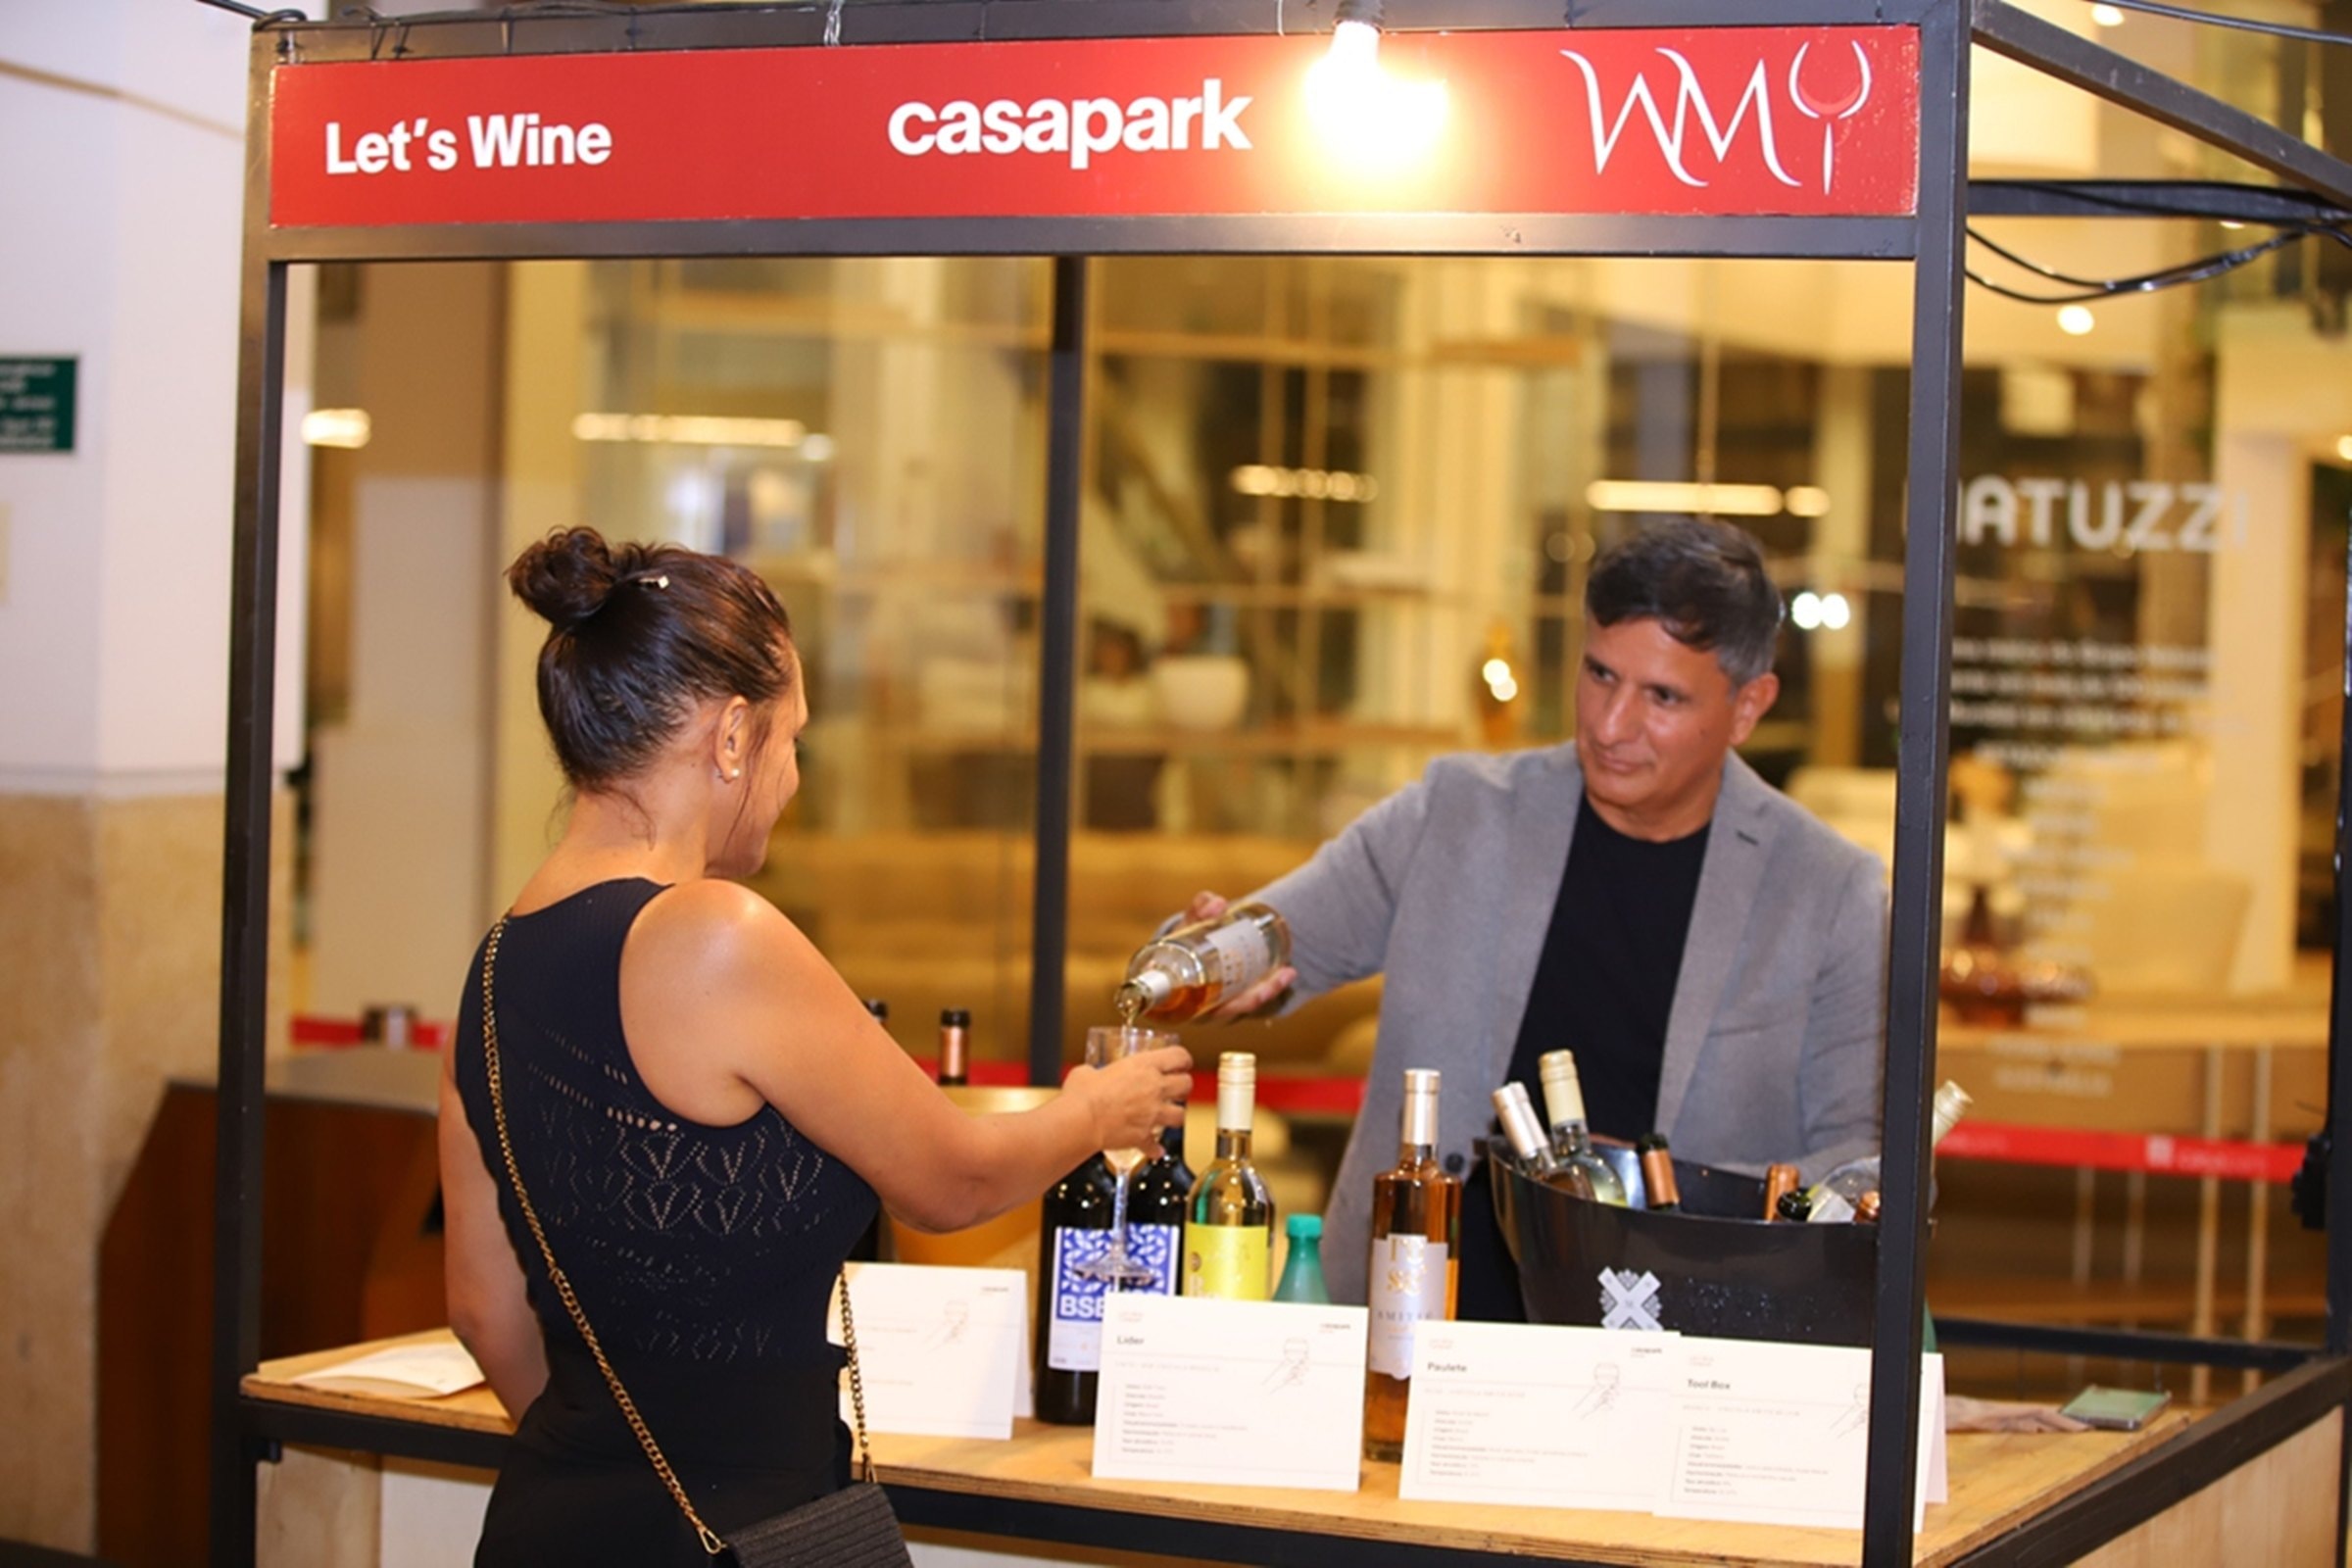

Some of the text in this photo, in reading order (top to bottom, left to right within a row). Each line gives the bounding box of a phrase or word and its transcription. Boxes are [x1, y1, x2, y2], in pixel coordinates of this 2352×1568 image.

[325, 113, 612, 173] Let's Wine
[888, 78, 1253, 170] casapark
[1904, 474, 2250, 552] ATUZZI
